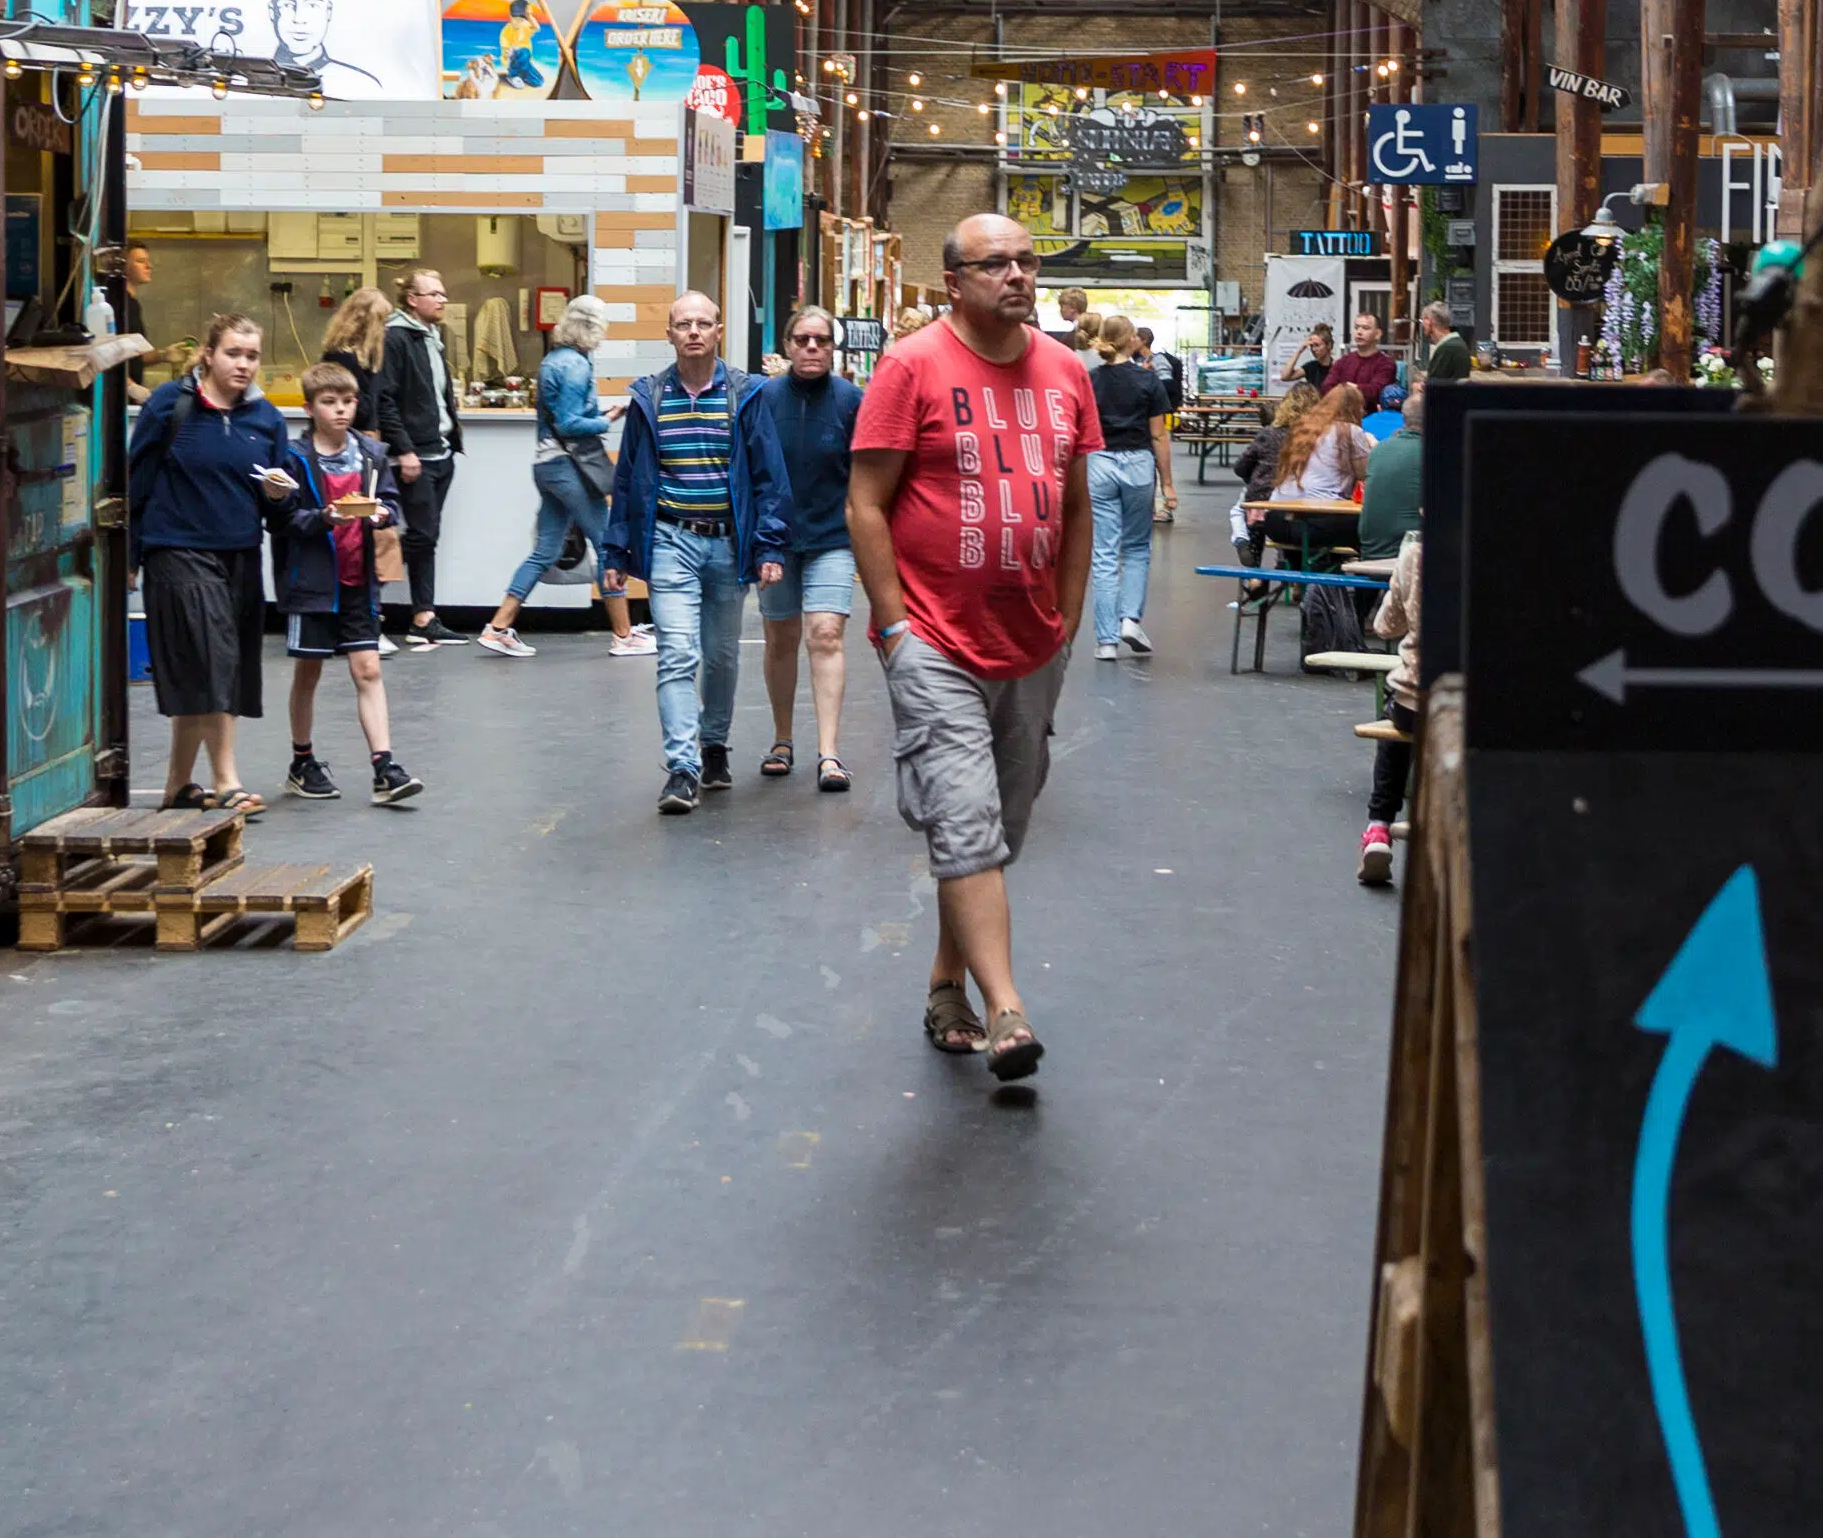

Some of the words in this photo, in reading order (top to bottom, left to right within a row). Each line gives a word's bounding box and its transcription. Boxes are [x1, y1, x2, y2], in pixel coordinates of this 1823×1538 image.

[1549, 68, 1580, 94] VIN
[1584, 79, 1623, 107] BAR
[952, 386, 1070, 432] BLUE
